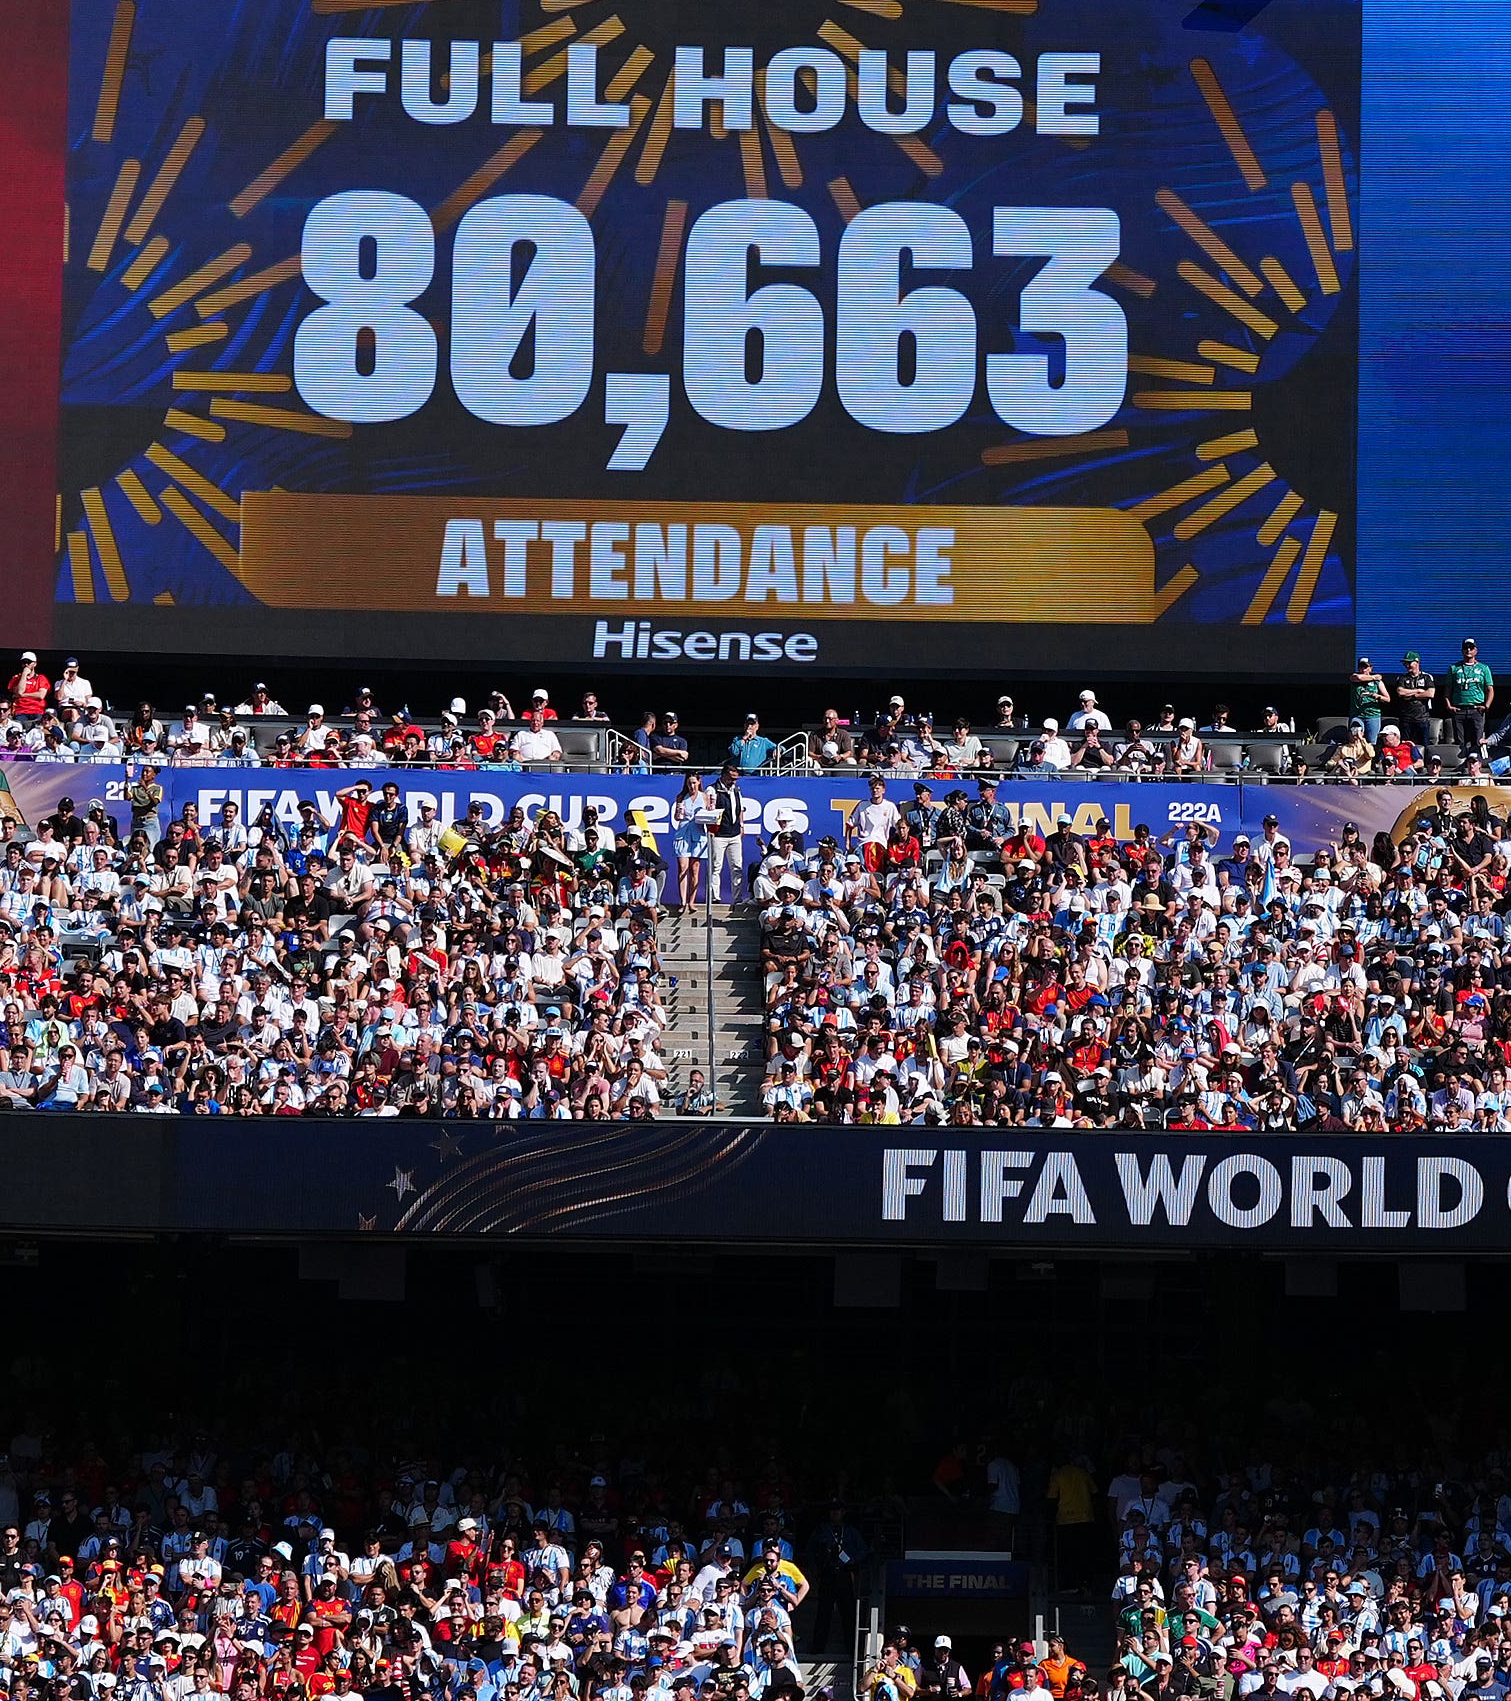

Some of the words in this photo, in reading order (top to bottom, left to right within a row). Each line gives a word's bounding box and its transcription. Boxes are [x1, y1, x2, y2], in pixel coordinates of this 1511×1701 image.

[324, 39, 631, 127] FULL
[673, 47, 1101, 136] HOUSE
[294, 190, 1128, 471] 80,663
[435, 518, 956, 605] ATTENDANCE
[593, 621, 818, 662] Hisense
[198, 789, 303, 827] FIFA
[1168, 802, 1222, 823] 222A
[674, 1049, 692, 1059] 221
[882, 1148, 1097, 1224] FIFA
[1114, 1152, 1484, 1229] WORLD
[902, 1573, 945, 1588] THE
[948, 1574, 1012, 1590] FINAL
